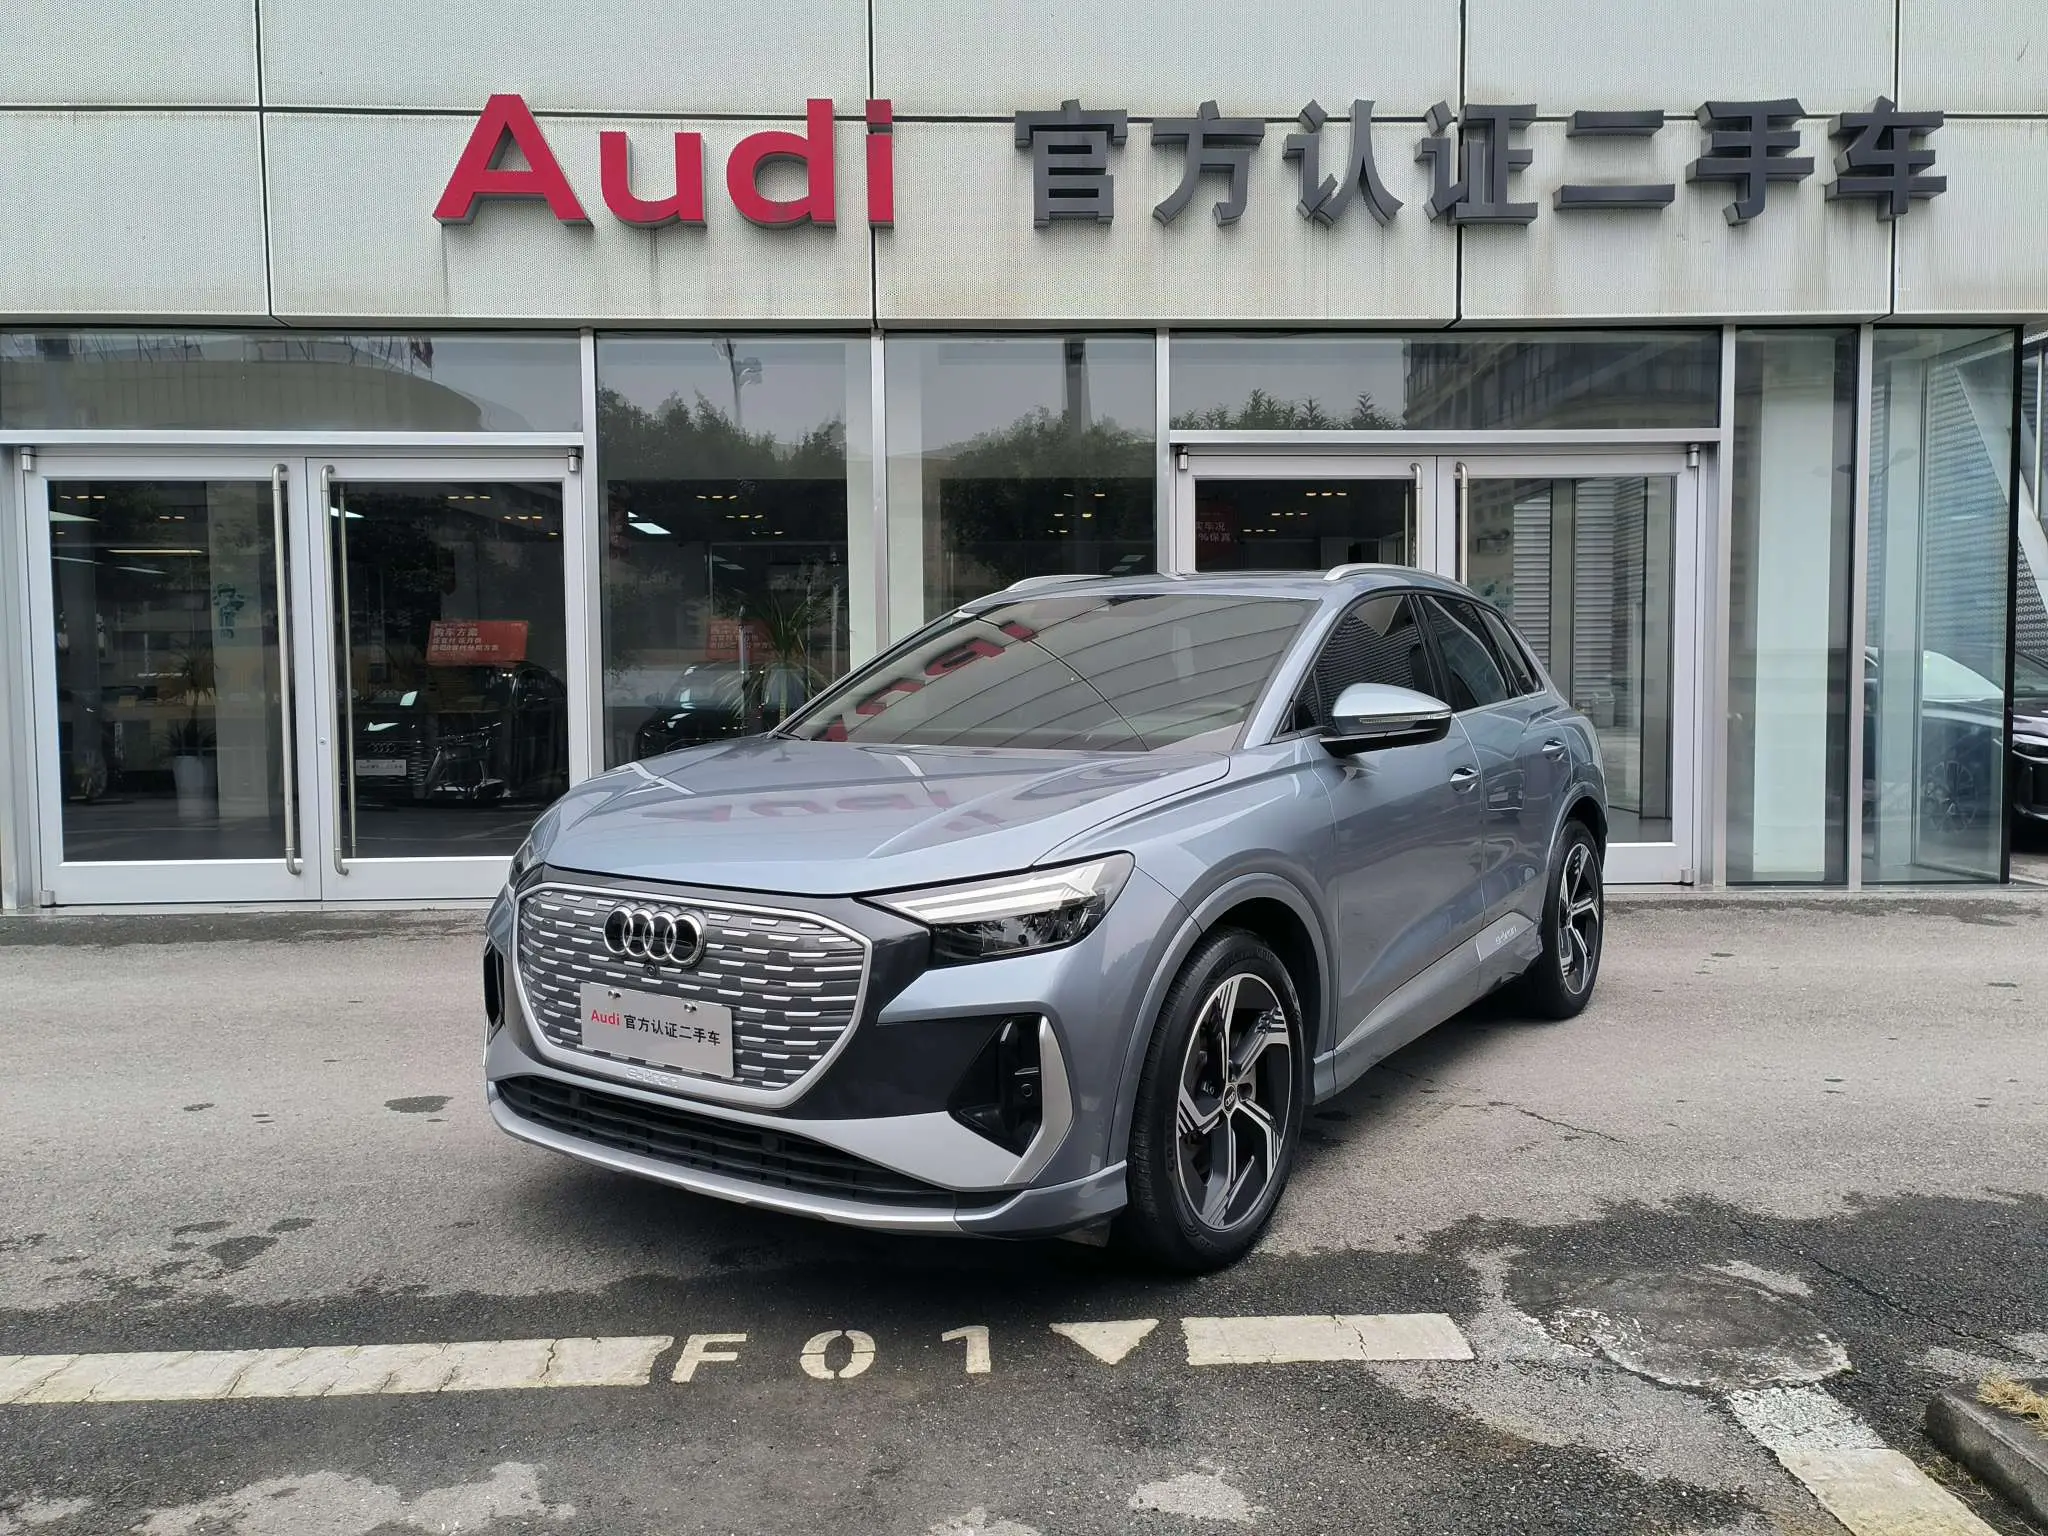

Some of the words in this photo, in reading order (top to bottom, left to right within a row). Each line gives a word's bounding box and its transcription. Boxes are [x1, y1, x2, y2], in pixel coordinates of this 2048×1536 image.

[432, 94, 895, 228] Audi
[1013, 96, 1948, 229] 官方认证二手车
[591, 1009, 620, 1026] Audi
[624, 1014, 720, 1046] 官方认证二手车
